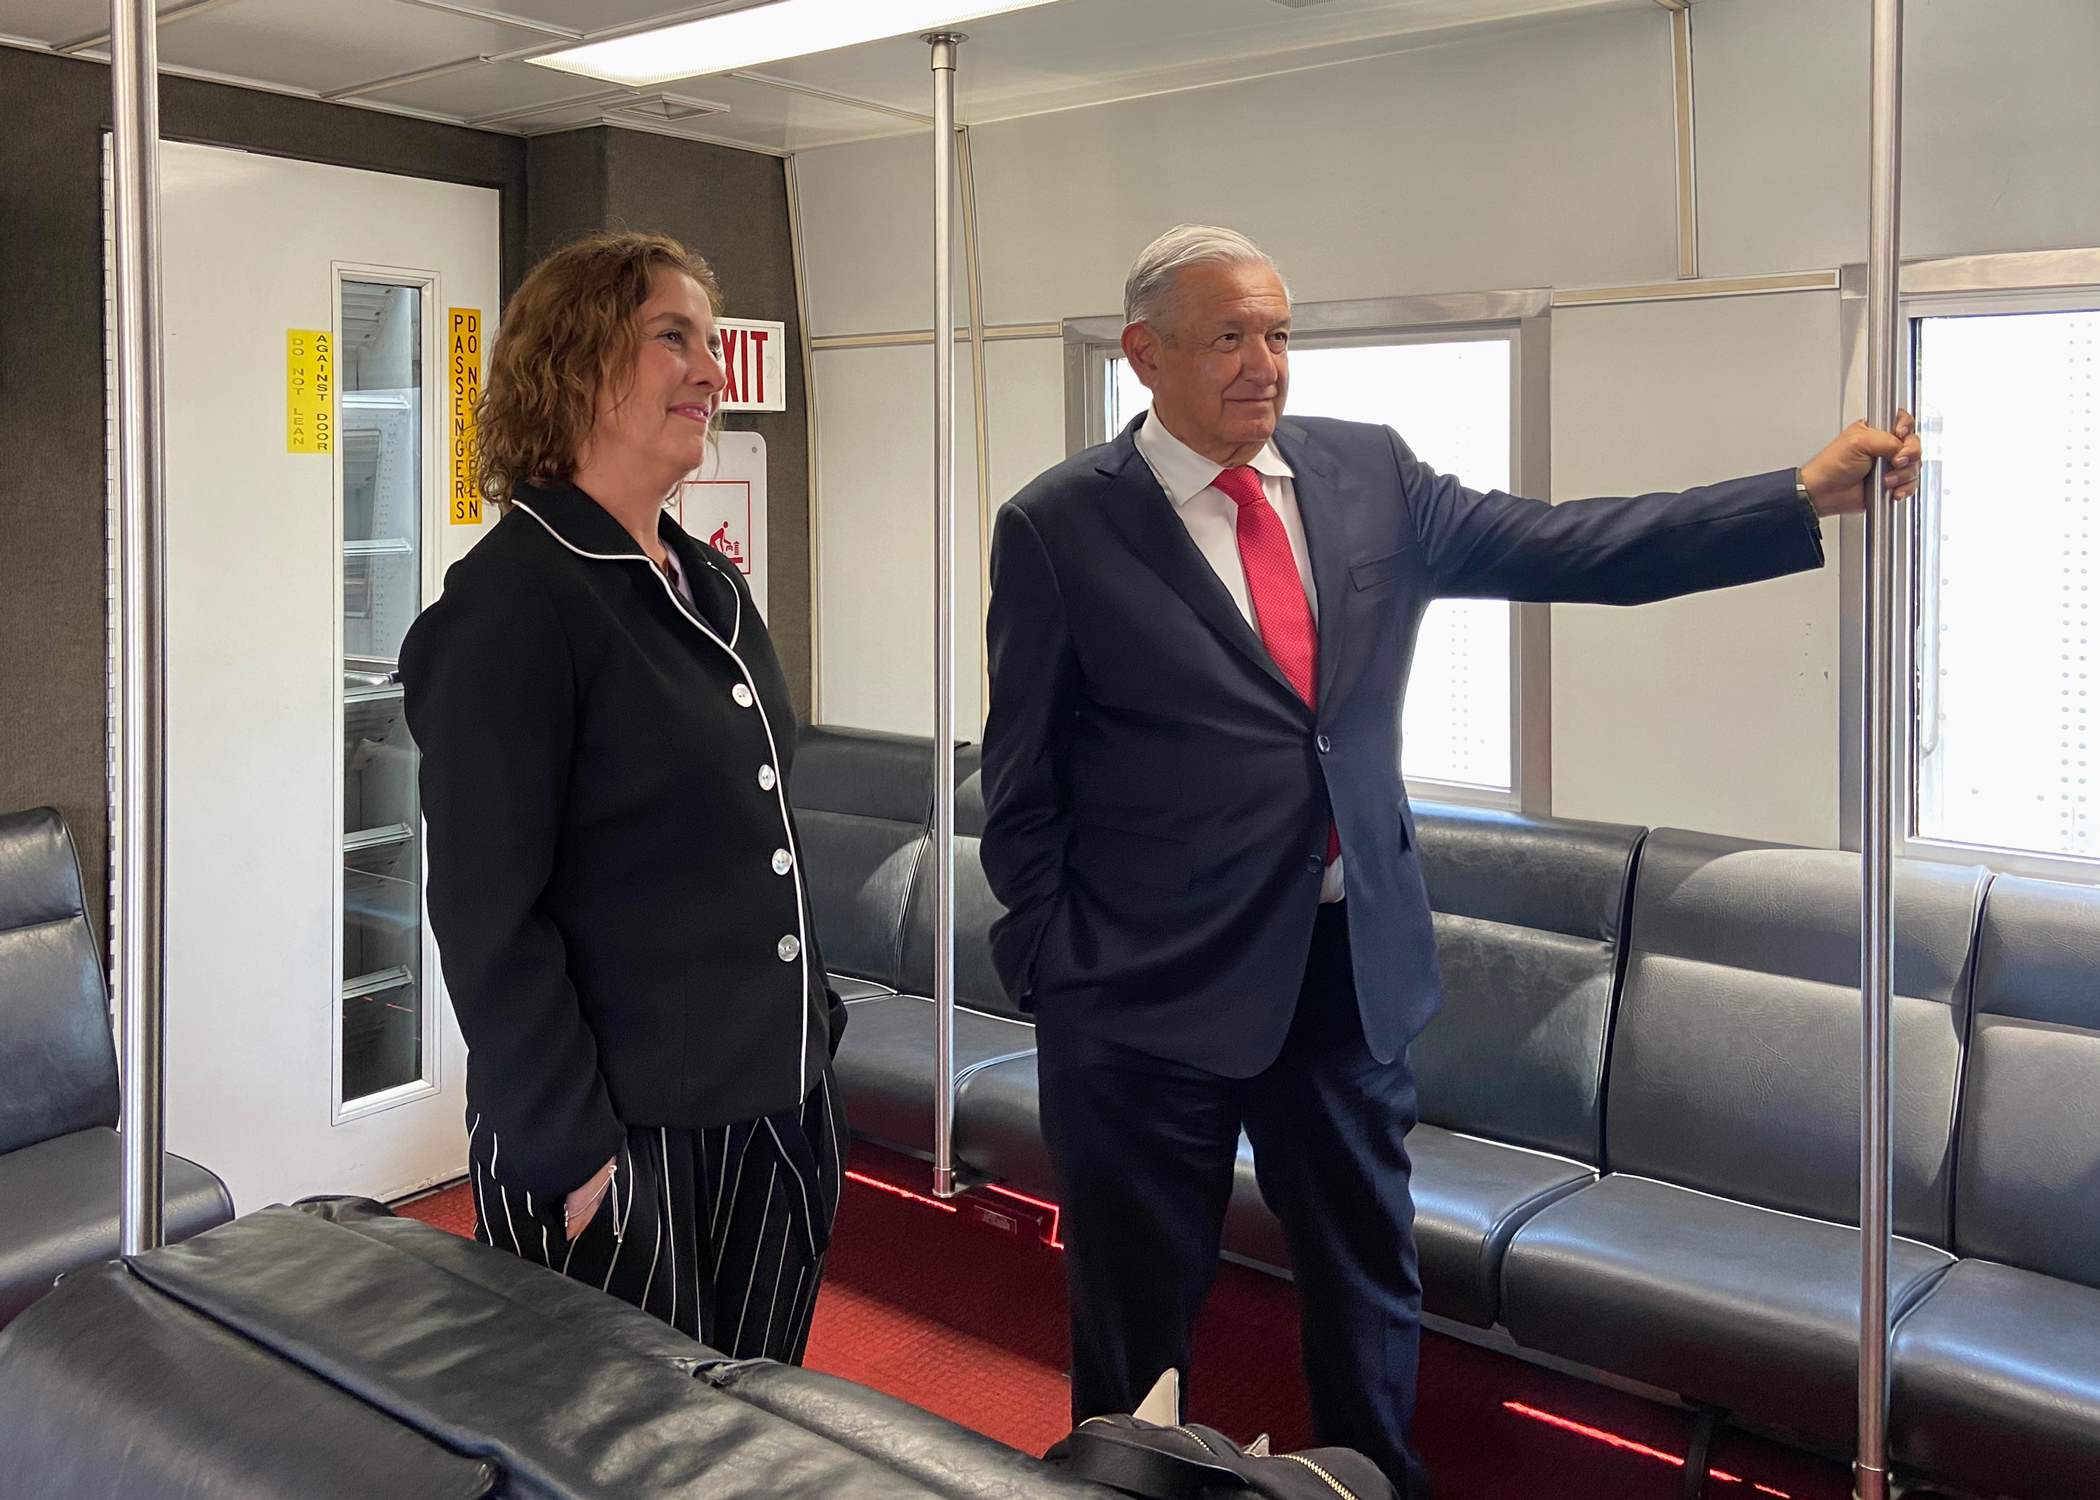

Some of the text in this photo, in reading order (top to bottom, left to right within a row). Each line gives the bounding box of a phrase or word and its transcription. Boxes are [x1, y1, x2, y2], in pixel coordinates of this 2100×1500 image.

[467, 315, 477, 353] DO
[719, 328, 768, 403] XIT
[291, 337, 305, 445] DO NOT LEAN
[316, 334, 329, 450] AGAINST DOOR
[454, 314, 465, 519] PASSENGERS
[468, 366, 478, 424] NO
